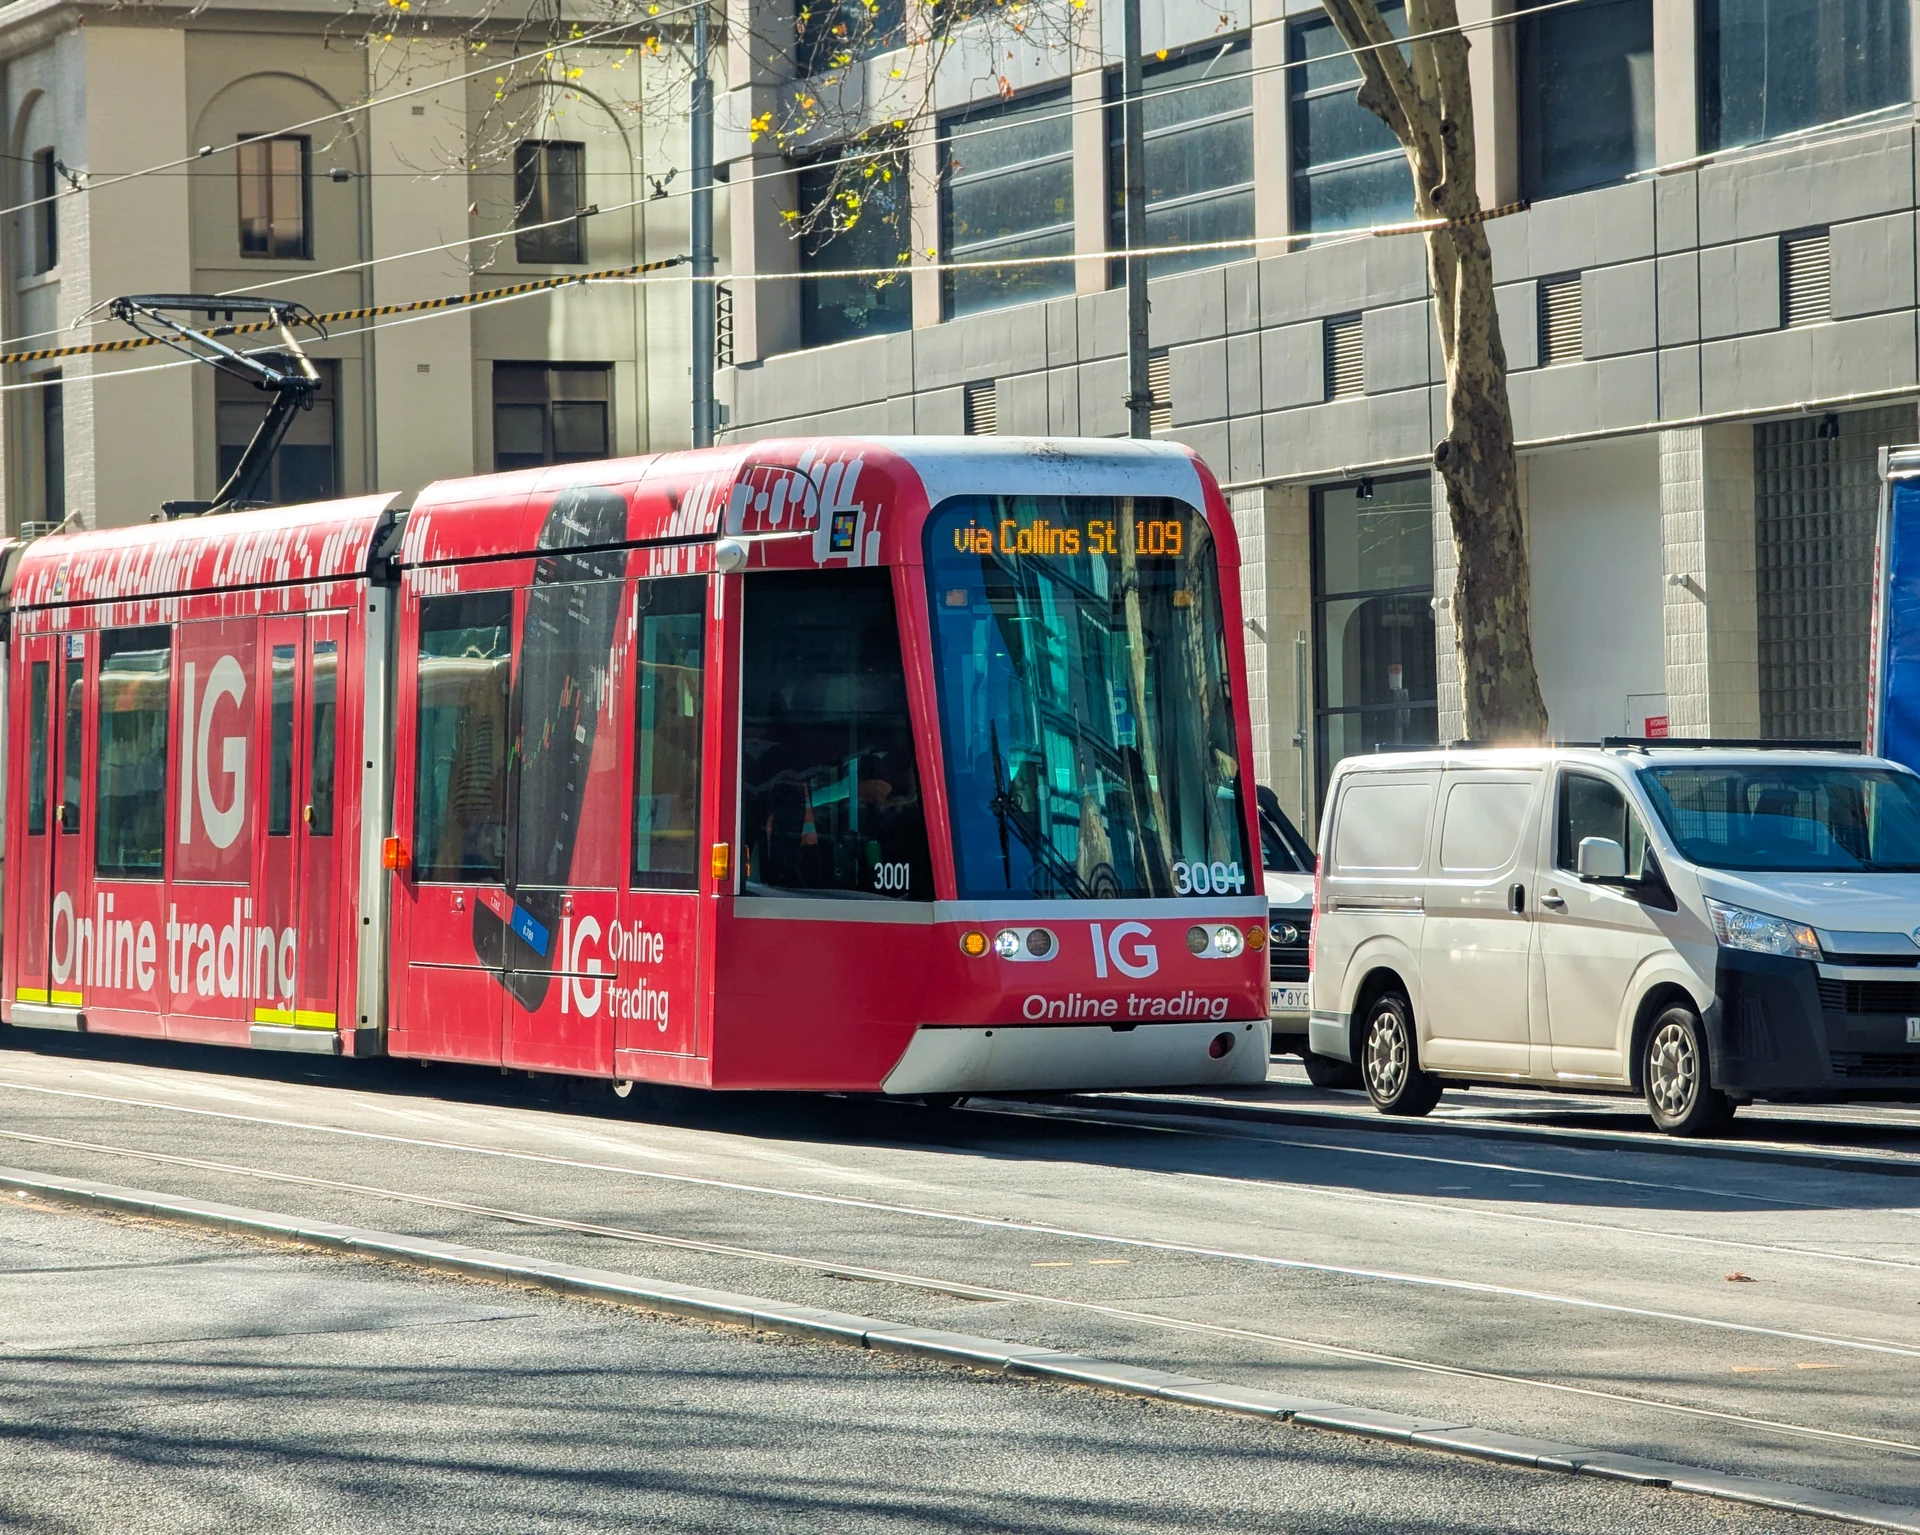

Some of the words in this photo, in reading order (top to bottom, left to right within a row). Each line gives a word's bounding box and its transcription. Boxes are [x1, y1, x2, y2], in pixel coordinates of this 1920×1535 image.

[954, 519, 992, 554] via
[1000, 519, 1080, 554] Collins
[1088, 520, 1117, 554] St
[1135, 520, 1182, 554] 109
[180, 654, 247, 849] IG
[1651, 728, 1668, 736] BOOSTE
[874, 862, 910, 890] 3001
[1173, 861, 1242, 894] 3001
[52, 891, 156, 992] Online
[166, 897, 297, 1012] trading
[608, 919, 664, 964] Online
[1090, 921, 1159, 979] IG
[561, 915, 602, 1018] IG
[608, 977, 669, 1032] trading
[1022, 994, 1118, 1020] Online
[1127, 990, 1229, 1020] trading
